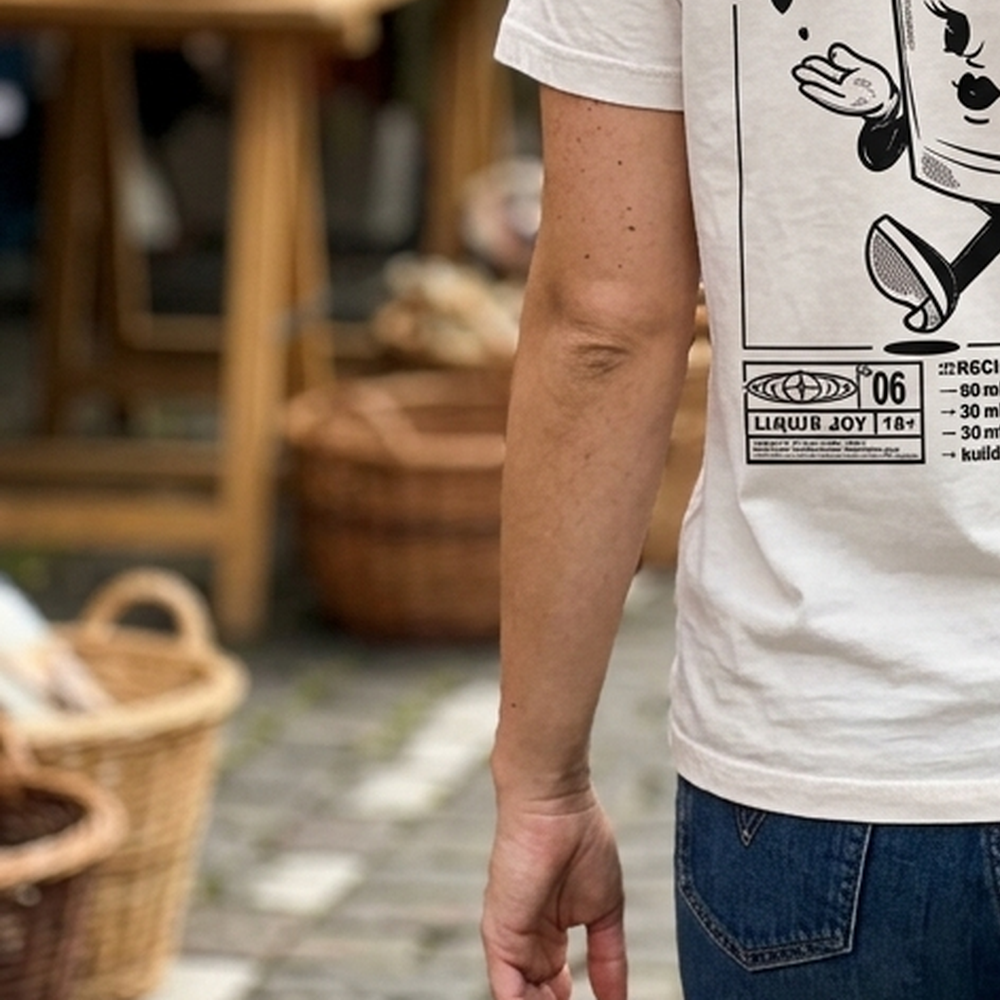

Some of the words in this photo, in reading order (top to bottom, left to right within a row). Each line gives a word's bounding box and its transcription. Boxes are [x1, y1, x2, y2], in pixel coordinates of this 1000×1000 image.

[872, 371, 906, 405] 06
[960, 403, 980, 419] 30
[882, 416, 915, 431] 18+
[961, 425, 981, 440] 30
